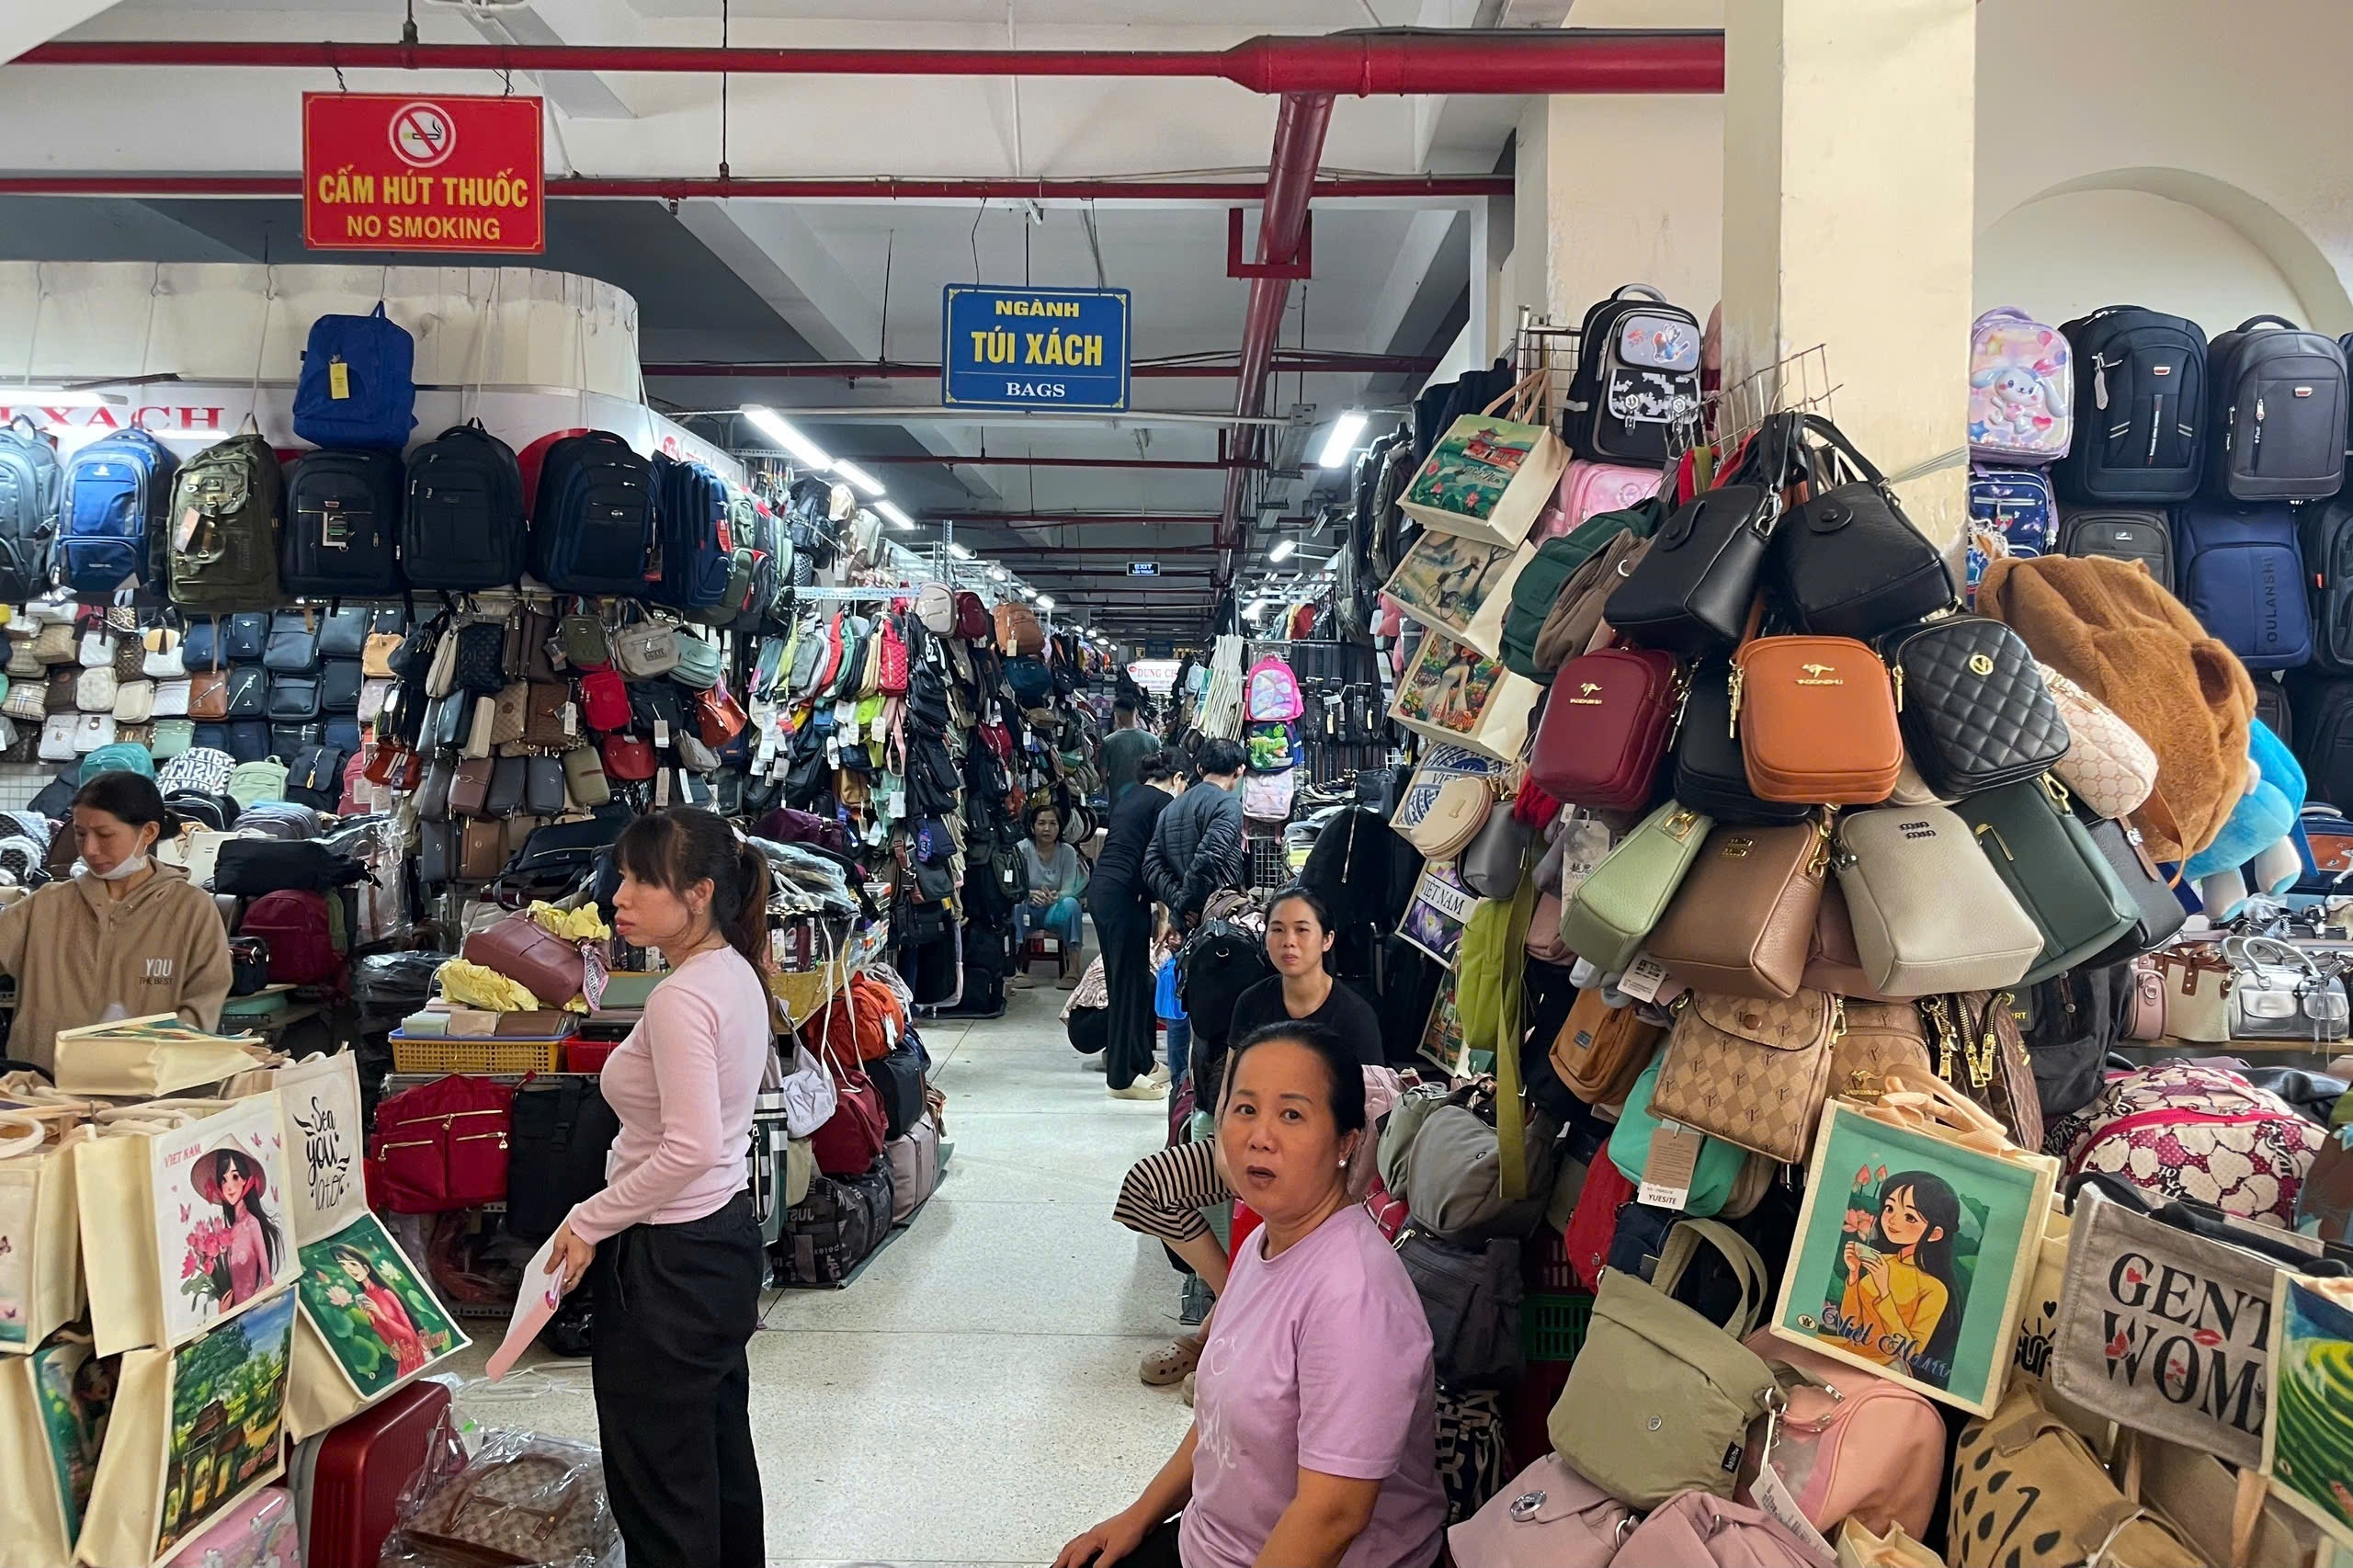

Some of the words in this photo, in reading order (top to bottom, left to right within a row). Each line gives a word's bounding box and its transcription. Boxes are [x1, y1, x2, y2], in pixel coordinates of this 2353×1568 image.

[319, 164, 374, 204] CẤM
[382, 169, 434, 205] HÚT
[441, 168, 529, 208] THUỐC
[347, 215, 381, 238] NO
[388, 215, 501, 240] SMOKING
[995, 299, 1080, 317] NGÀNH
[971, 325, 1016, 364] TÚI
[1025, 327, 1103, 367] XÁCH
[1006, 382, 1065, 398] BAGS
[1437, 889, 1465, 915] NAM
[146, 958, 173, 977] YOU
[139, 976, 153, 985] THE
[153, 977, 174, 985] BEST
[2011, 1011, 2027, 1019] RT
[306, 1134, 338, 1187] you
[1648, 1193, 1677, 1205] YUESITE
